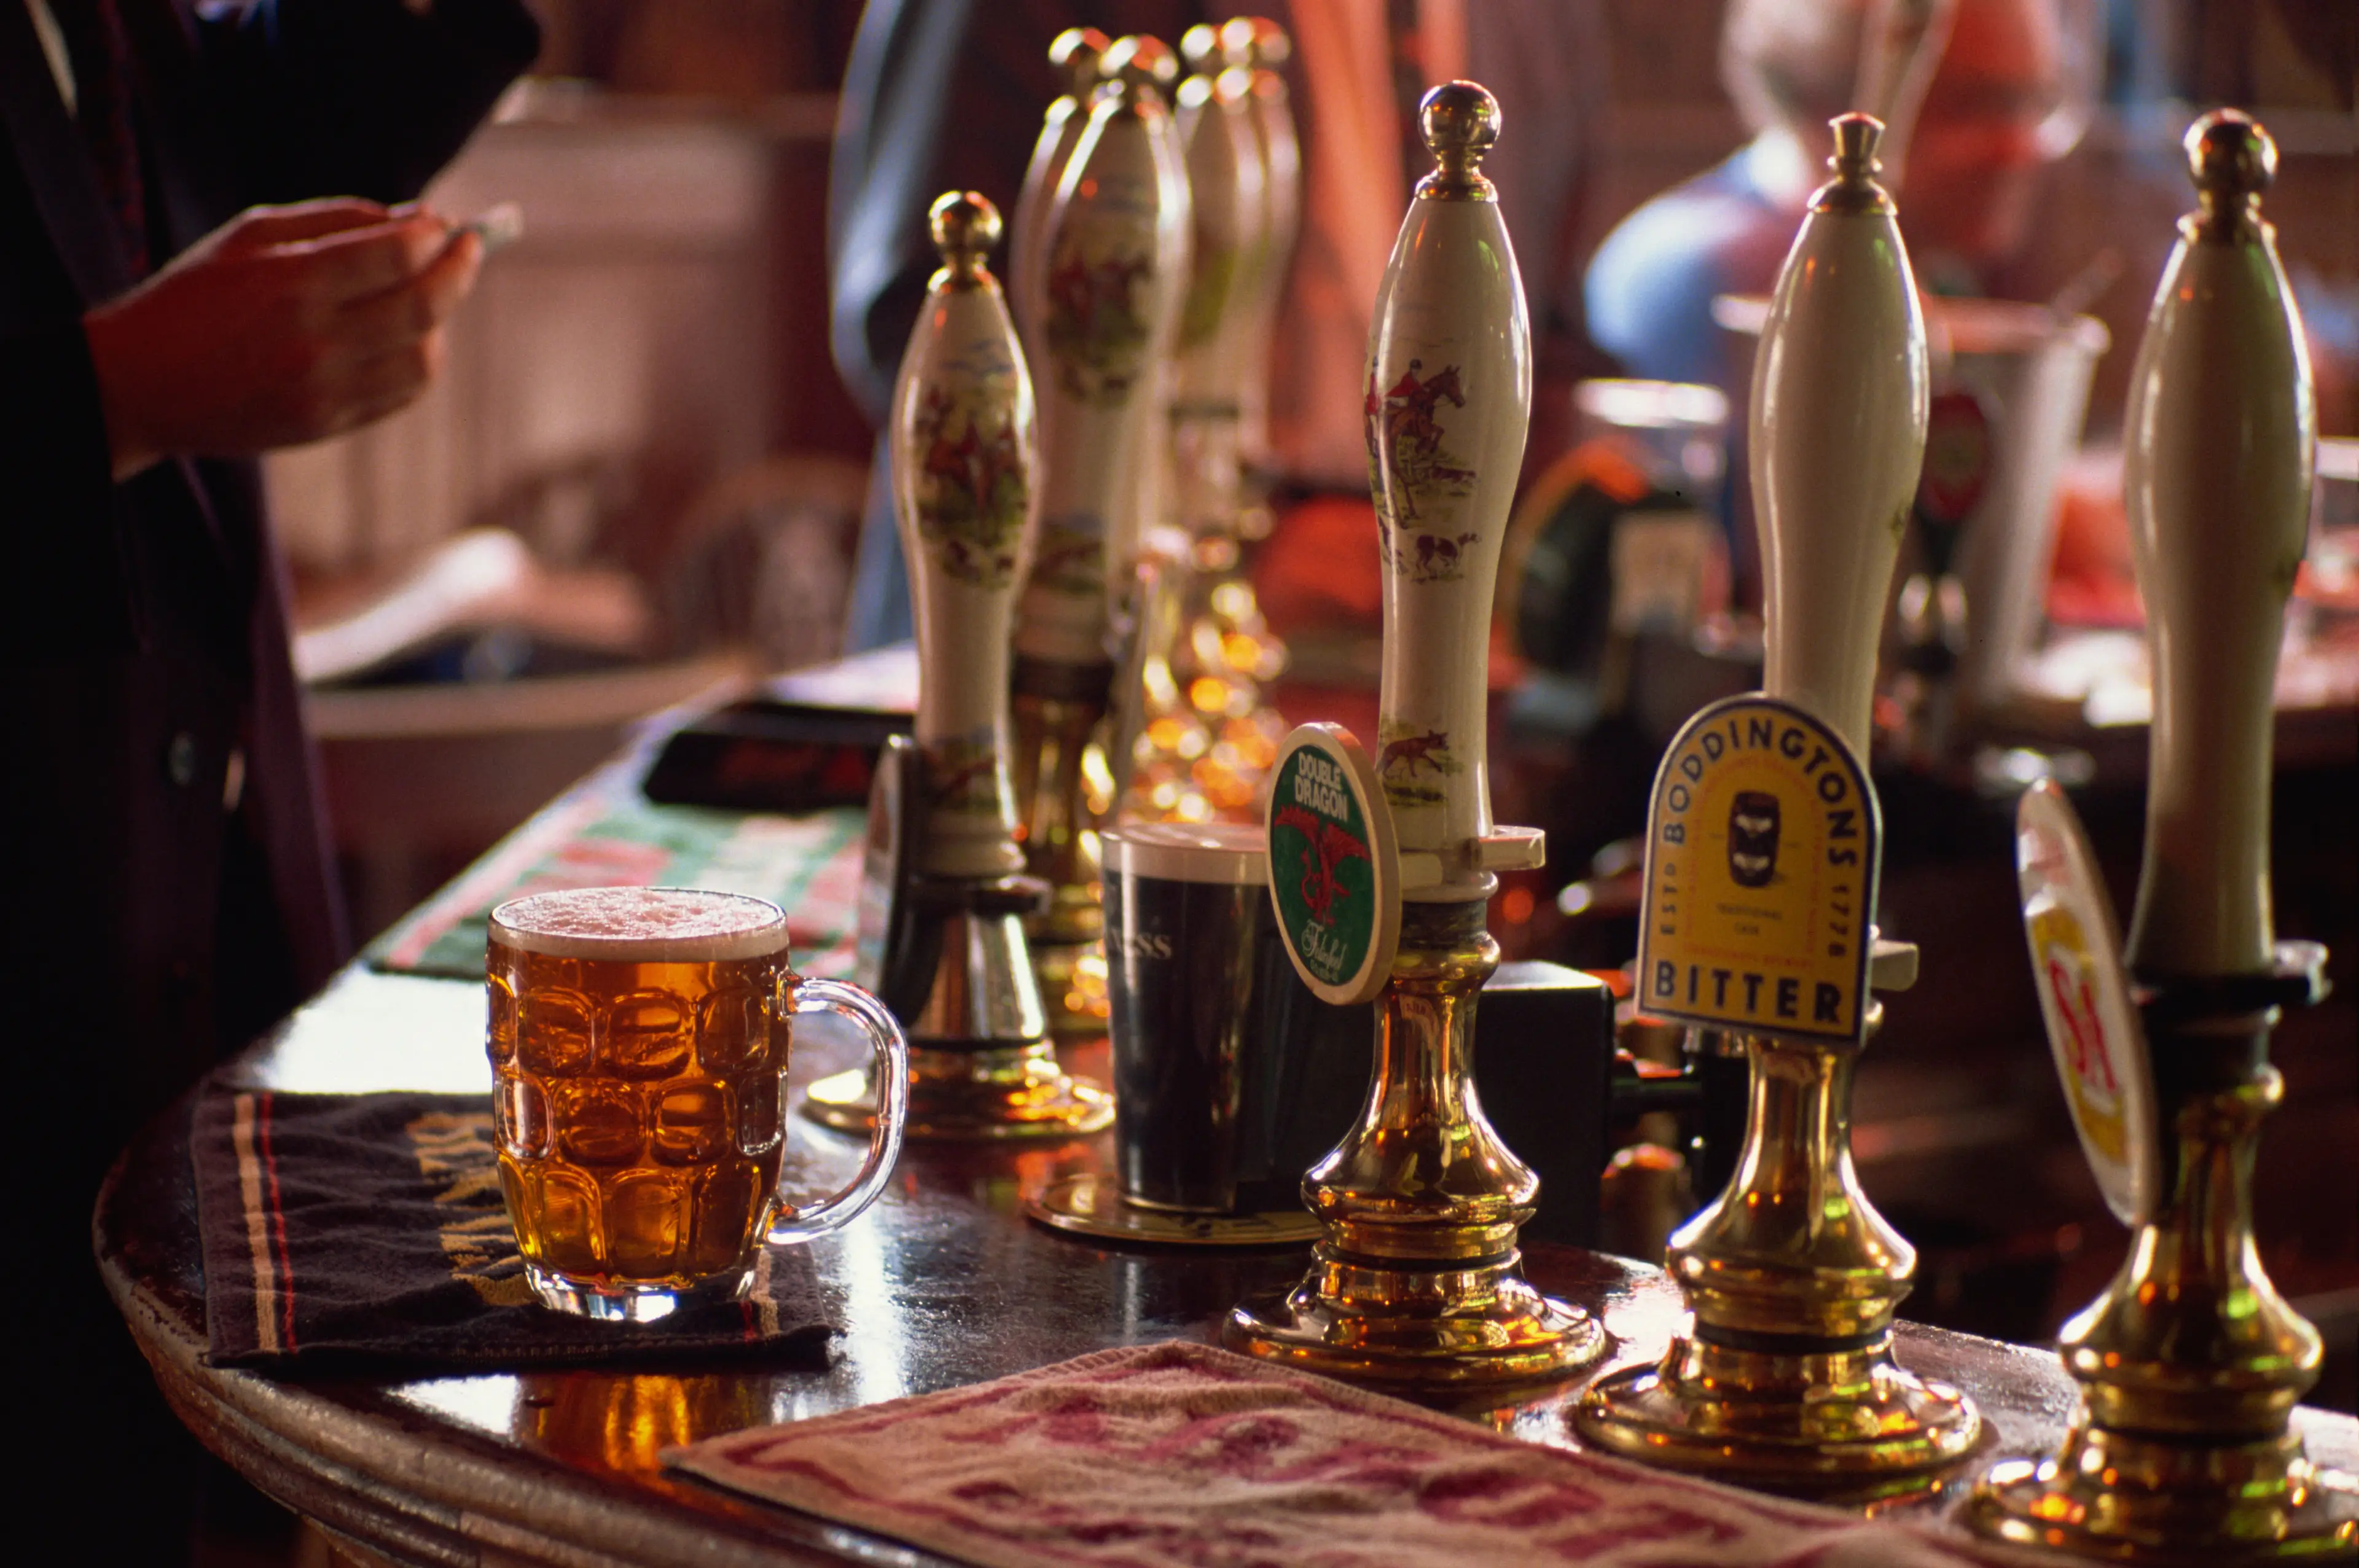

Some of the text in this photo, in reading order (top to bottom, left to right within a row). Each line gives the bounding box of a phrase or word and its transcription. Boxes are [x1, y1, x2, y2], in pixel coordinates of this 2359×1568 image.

[1295, 774, 1348, 822] DRAGON
[1299, 752, 1342, 791] DOUBLE
[1662, 717, 1857, 868] BODDINGTONS
[1654, 959, 1842, 1023] BITTER
